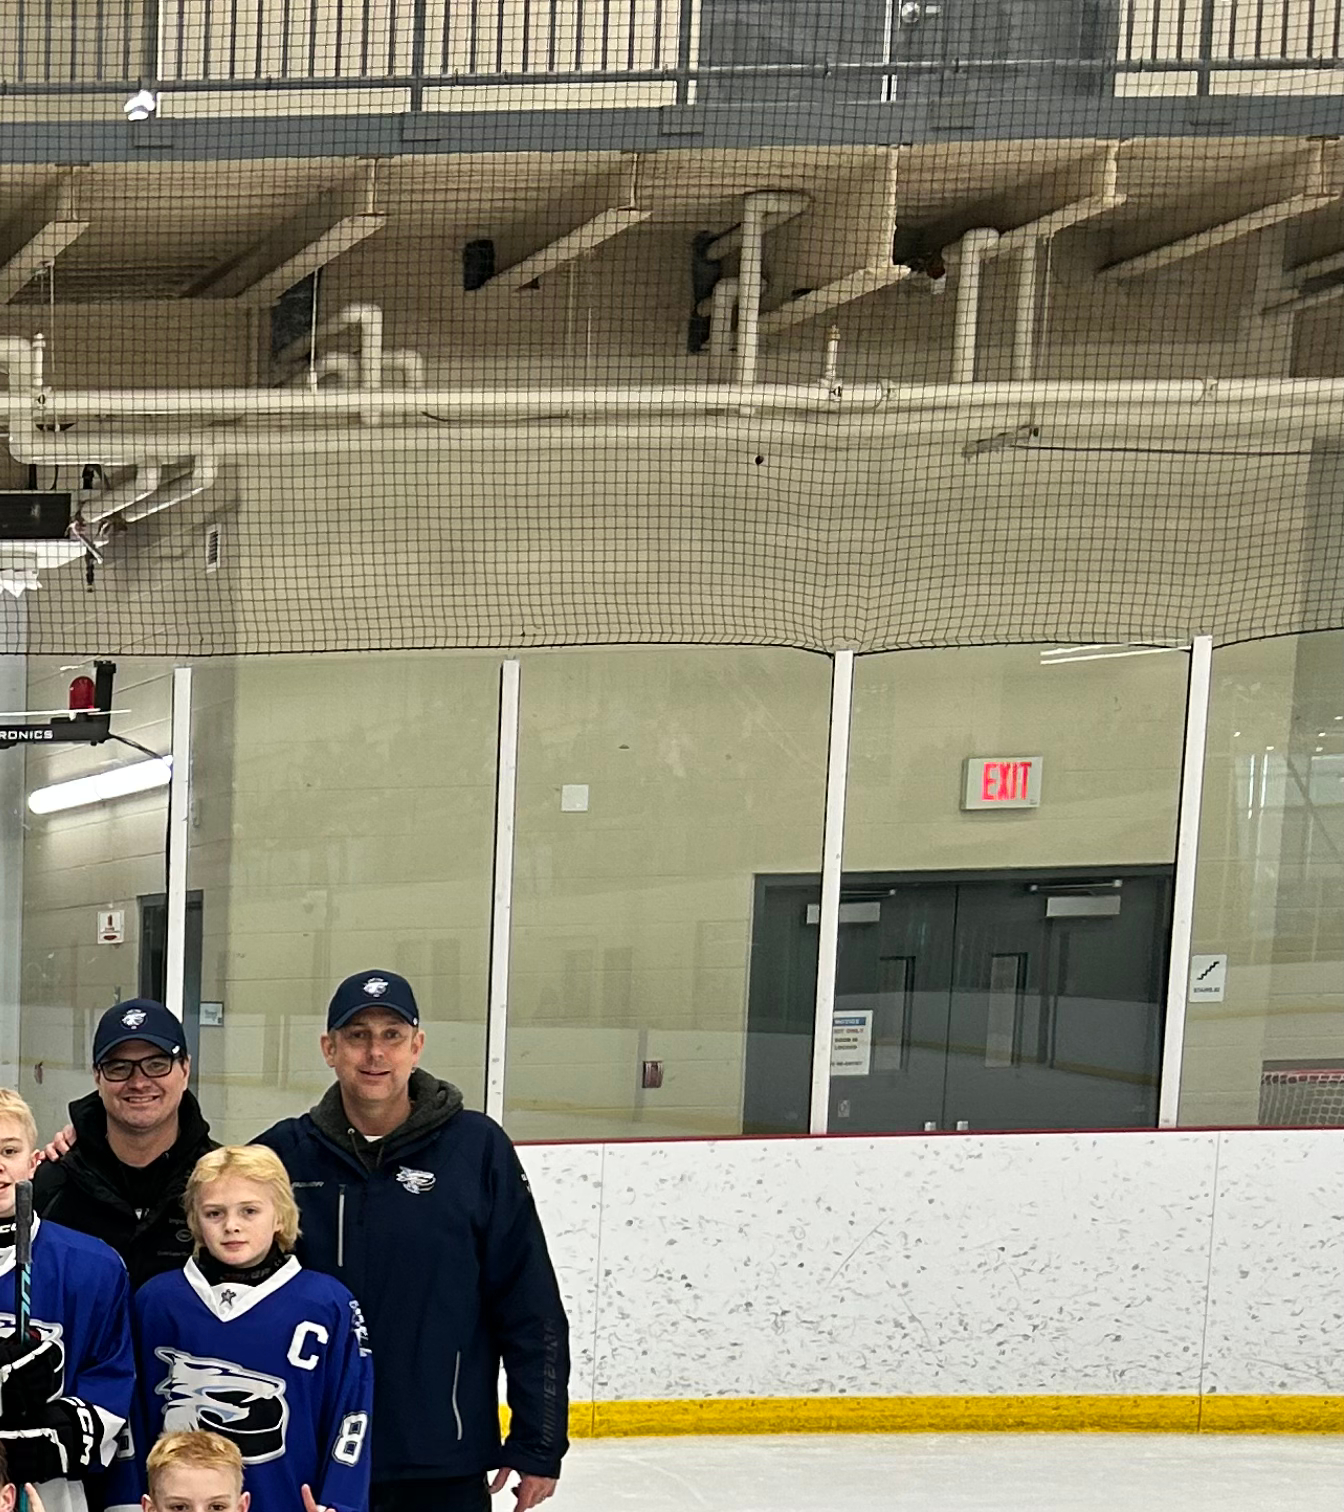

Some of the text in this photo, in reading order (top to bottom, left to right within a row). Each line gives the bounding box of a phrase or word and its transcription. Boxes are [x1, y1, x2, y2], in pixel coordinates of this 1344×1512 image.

[982, 762, 1033, 801] EXIT
[286, 1319, 330, 1371] C
[331, 1410, 370, 1467] 8
